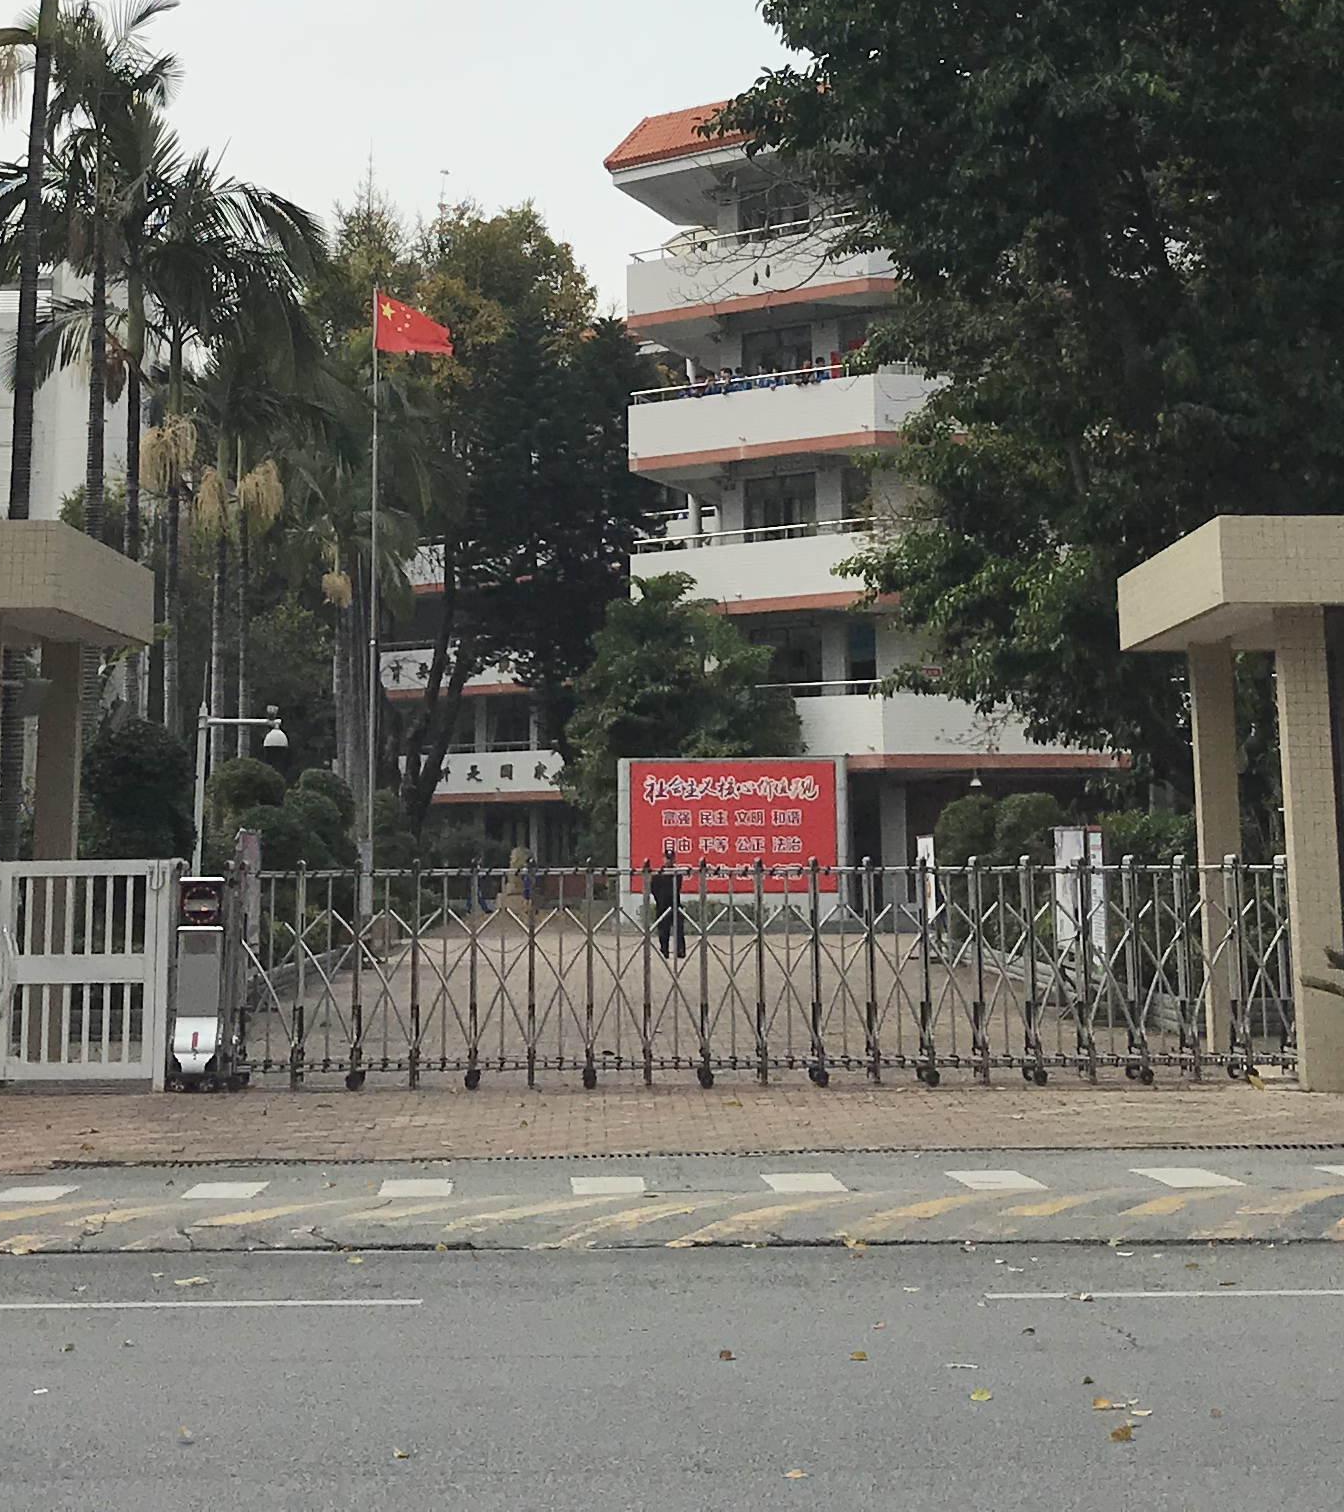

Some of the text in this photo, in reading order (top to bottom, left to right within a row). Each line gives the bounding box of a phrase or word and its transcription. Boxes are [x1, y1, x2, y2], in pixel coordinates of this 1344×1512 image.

[643, 774, 820, 805] 社会主义核心价值观
[662, 809, 802, 827] 富强 民主 文明 和谐
[662, 836, 802, 853] 自由 平等 公正 法治
